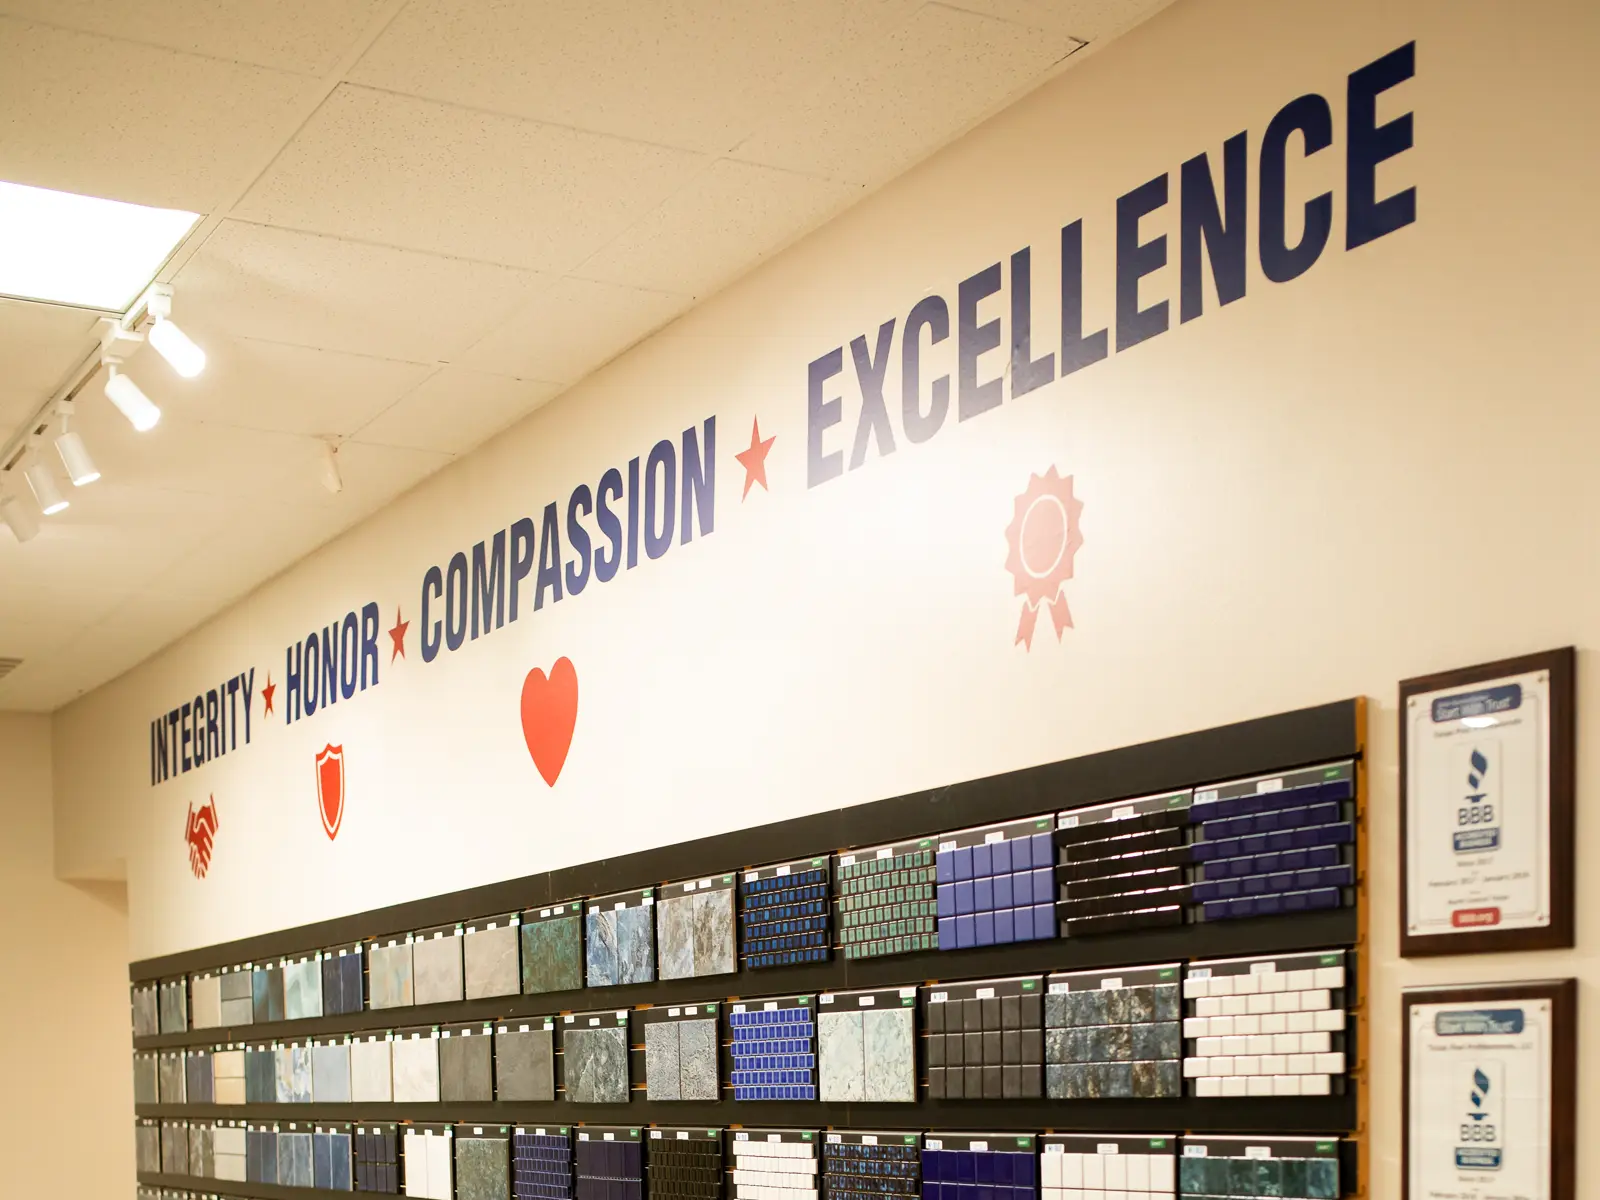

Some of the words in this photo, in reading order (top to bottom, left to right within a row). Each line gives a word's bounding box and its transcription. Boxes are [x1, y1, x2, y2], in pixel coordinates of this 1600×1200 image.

[151, 667, 254, 786] INTEGRITY
[286, 601, 379, 725] HONOR
[420, 415, 716, 662] COMPASSION
[807, 42, 1416, 490] EXCELLENCE
[1458, 804, 1493, 826] BBB
[1460, 1123, 1496, 1142] BBB
